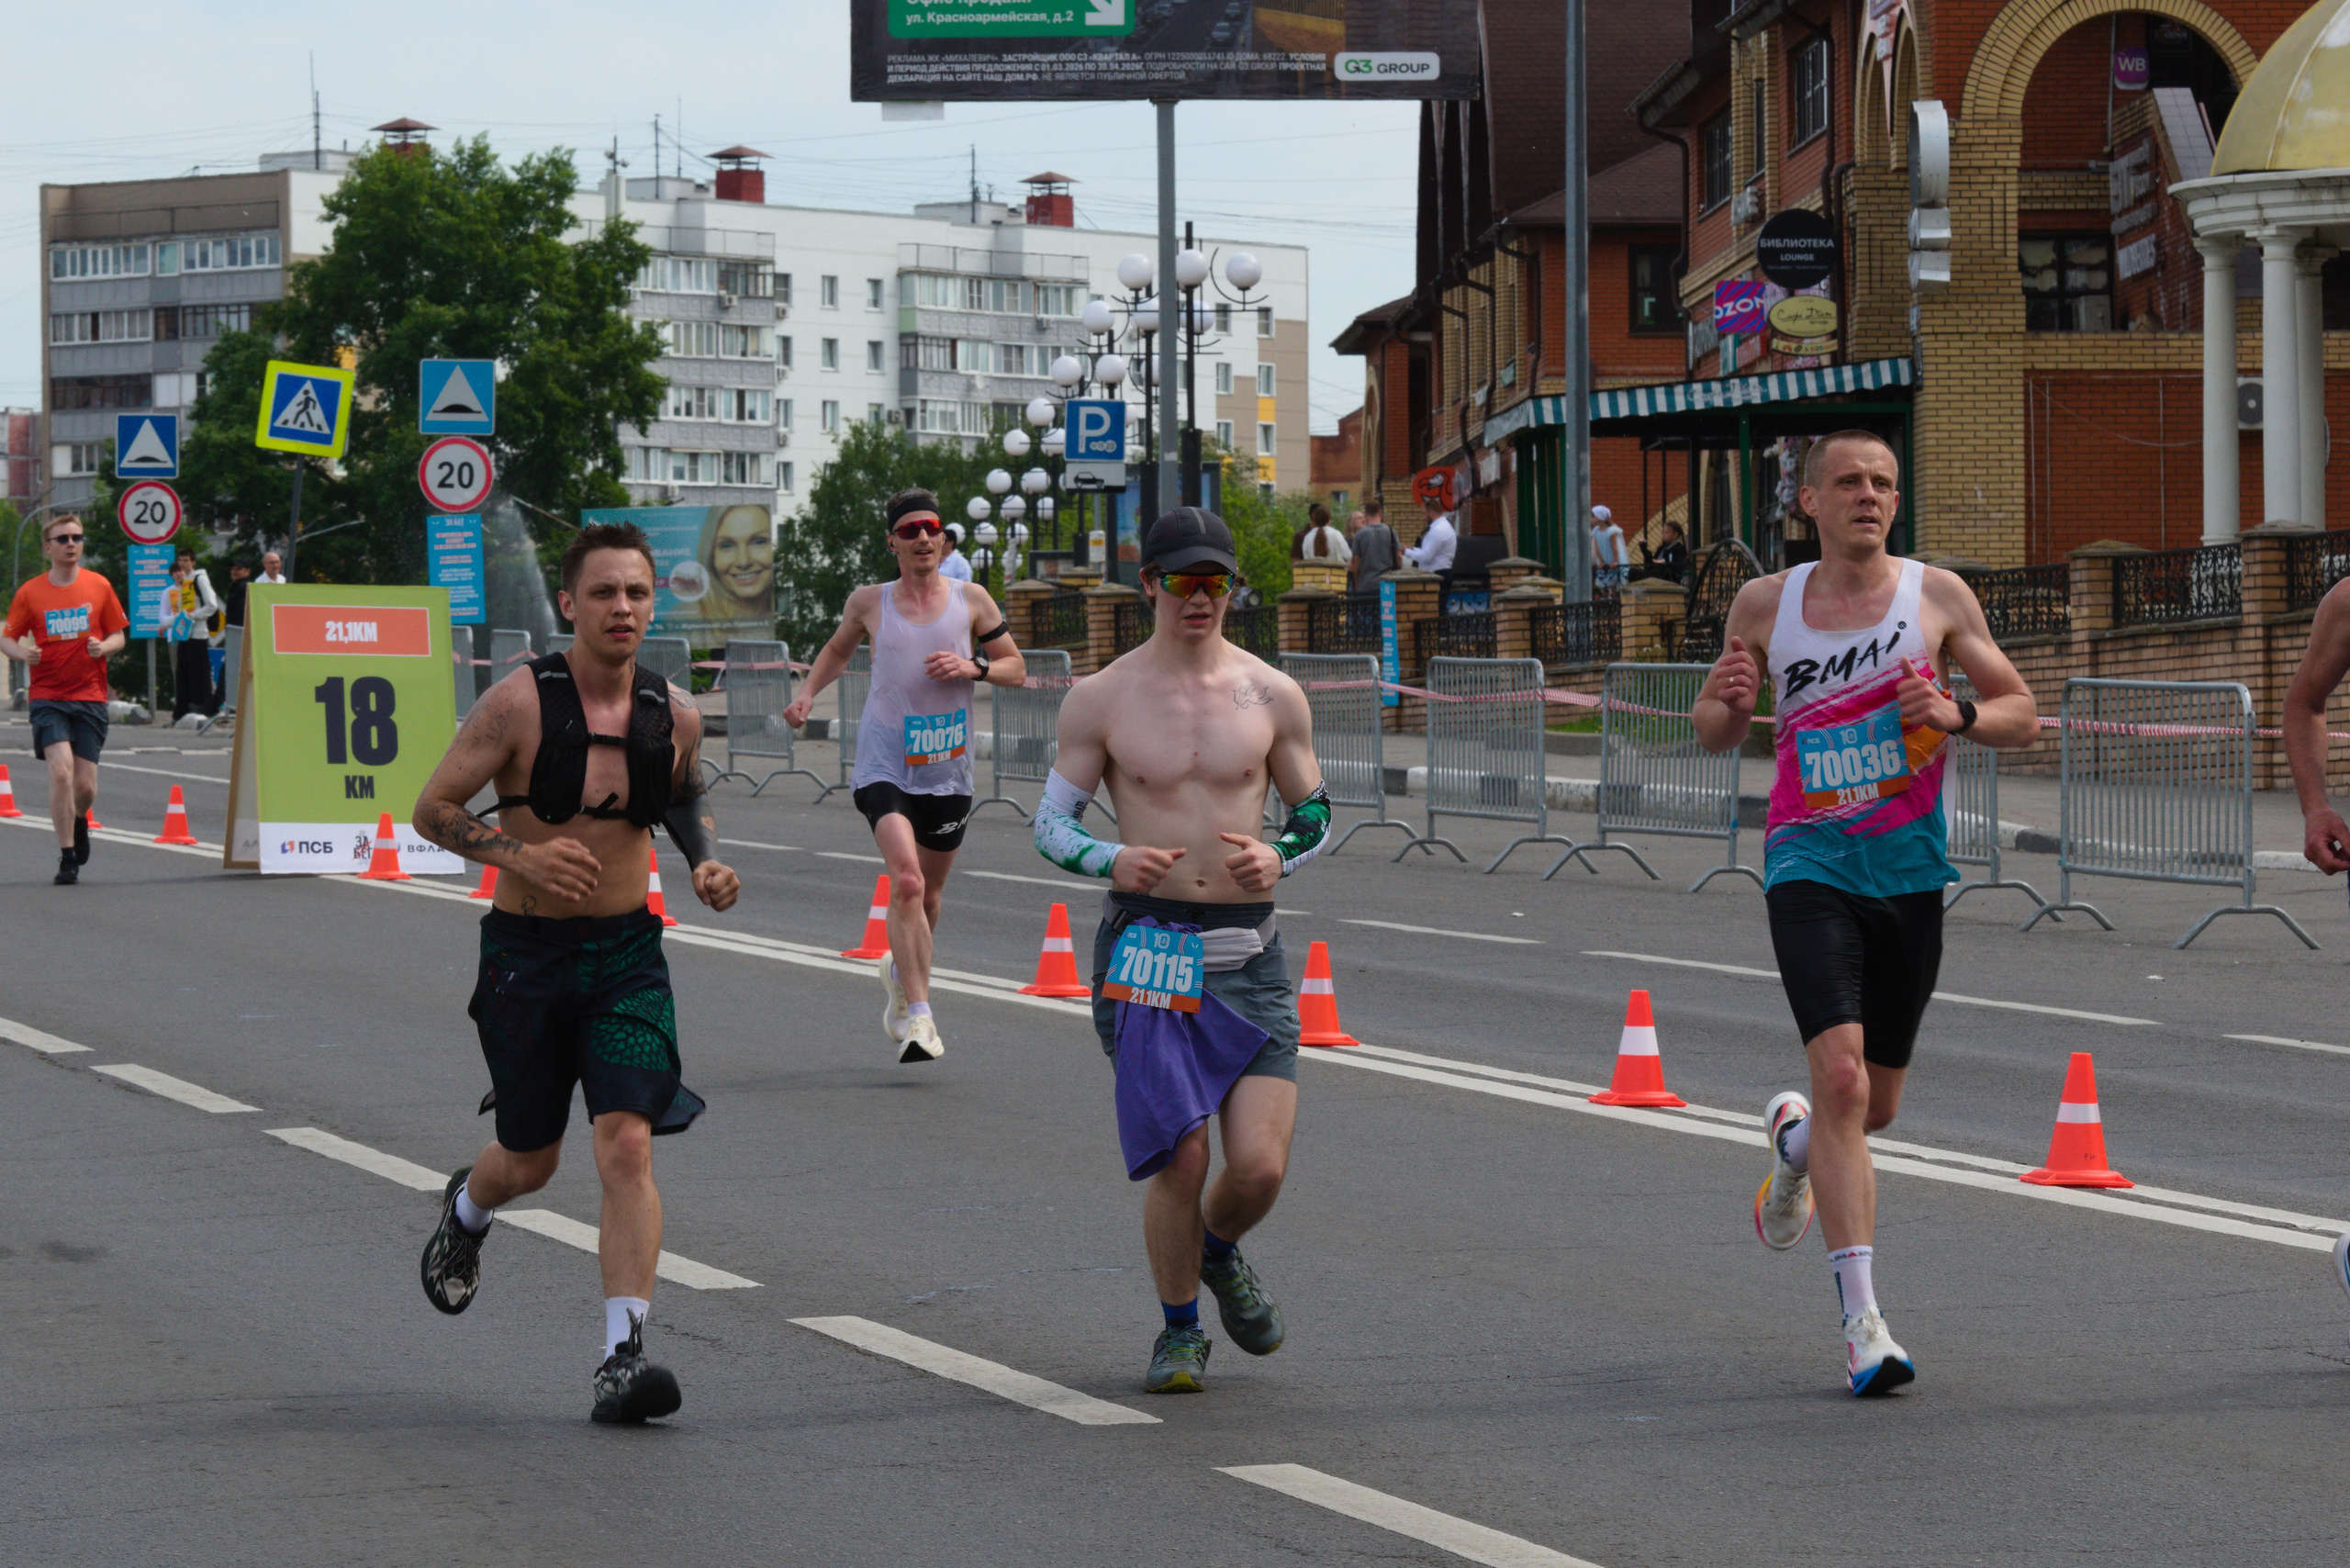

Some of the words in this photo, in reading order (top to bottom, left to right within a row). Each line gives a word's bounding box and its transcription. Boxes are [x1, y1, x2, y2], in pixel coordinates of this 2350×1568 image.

[906, 14, 924, 26] ул.
[927, 11, 1050, 25] Красноармейская,
[1053, 10, 1074, 23] д.2
[888, 54, 926, 62] РЕКЛАМА
[927, 54, 940, 62] ЖК
[1002, 51, 1058, 62] ЗАСТРОЙЩИК
[1058, 53, 1076, 62] ООО
[1077, 53, 1088, 62] СЗ
[1144, 52, 1166, 61] ОГРН
[1289, 52, 1326, 62] УСЛОВИЯ
[2118, 57, 2146, 72] WB
[887, 64, 894, 73] И
[895, 64, 928, 73] ПЕРИОД
[928, 62, 970, 73] ДЕЙСТВИЯ
[972, 63, 1033, 73] ПРЕДЛОЖЕНИЯ
[1034, 63, 1040, 72] С
[1085, 63, 1096, 72] ПО
[1147, 62, 1205, 71] ПОДРОБНОСТИ
[1206, 62, 1218, 71] НА
[1279, 62, 1326, 71] ПРОЕКТНАЯ
[1345, 59, 1372, 73] G3
[1377, 63, 1429, 73] GROUP
[887, 74, 941, 84] ДЕКЛАРАЦИЯ
[942, 73, 955, 82] НА
[956, 72, 981, 82] САЙТЕ
[1042, 73, 1053, 81] НЕ
[1054, 73, 1096, 81] ЯВЛЯЕТСЯ
[1096, 71, 1147, 81] ПУБЛИЧНОЙ
[1760, 239, 1834, 248] БИБЛИОТЕКА
[1780, 253, 1815, 262] LOUNGE
[1078, 406, 1111, 454] P
[437, 461, 474, 489] 20
[133, 500, 166, 524] 20
[48, 615, 88, 633] 70099
[325, 621, 378, 644] 21,1КМ
[315, 676, 398, 767] 18
[910, 723, 963, 753] 70076
[1805, 739, 1901, 789] 70036
[344, 775, 375, 799] КМ
[298, 841, 333, 854] ПСБ
[1119, 945, 1193, 992] 70115
